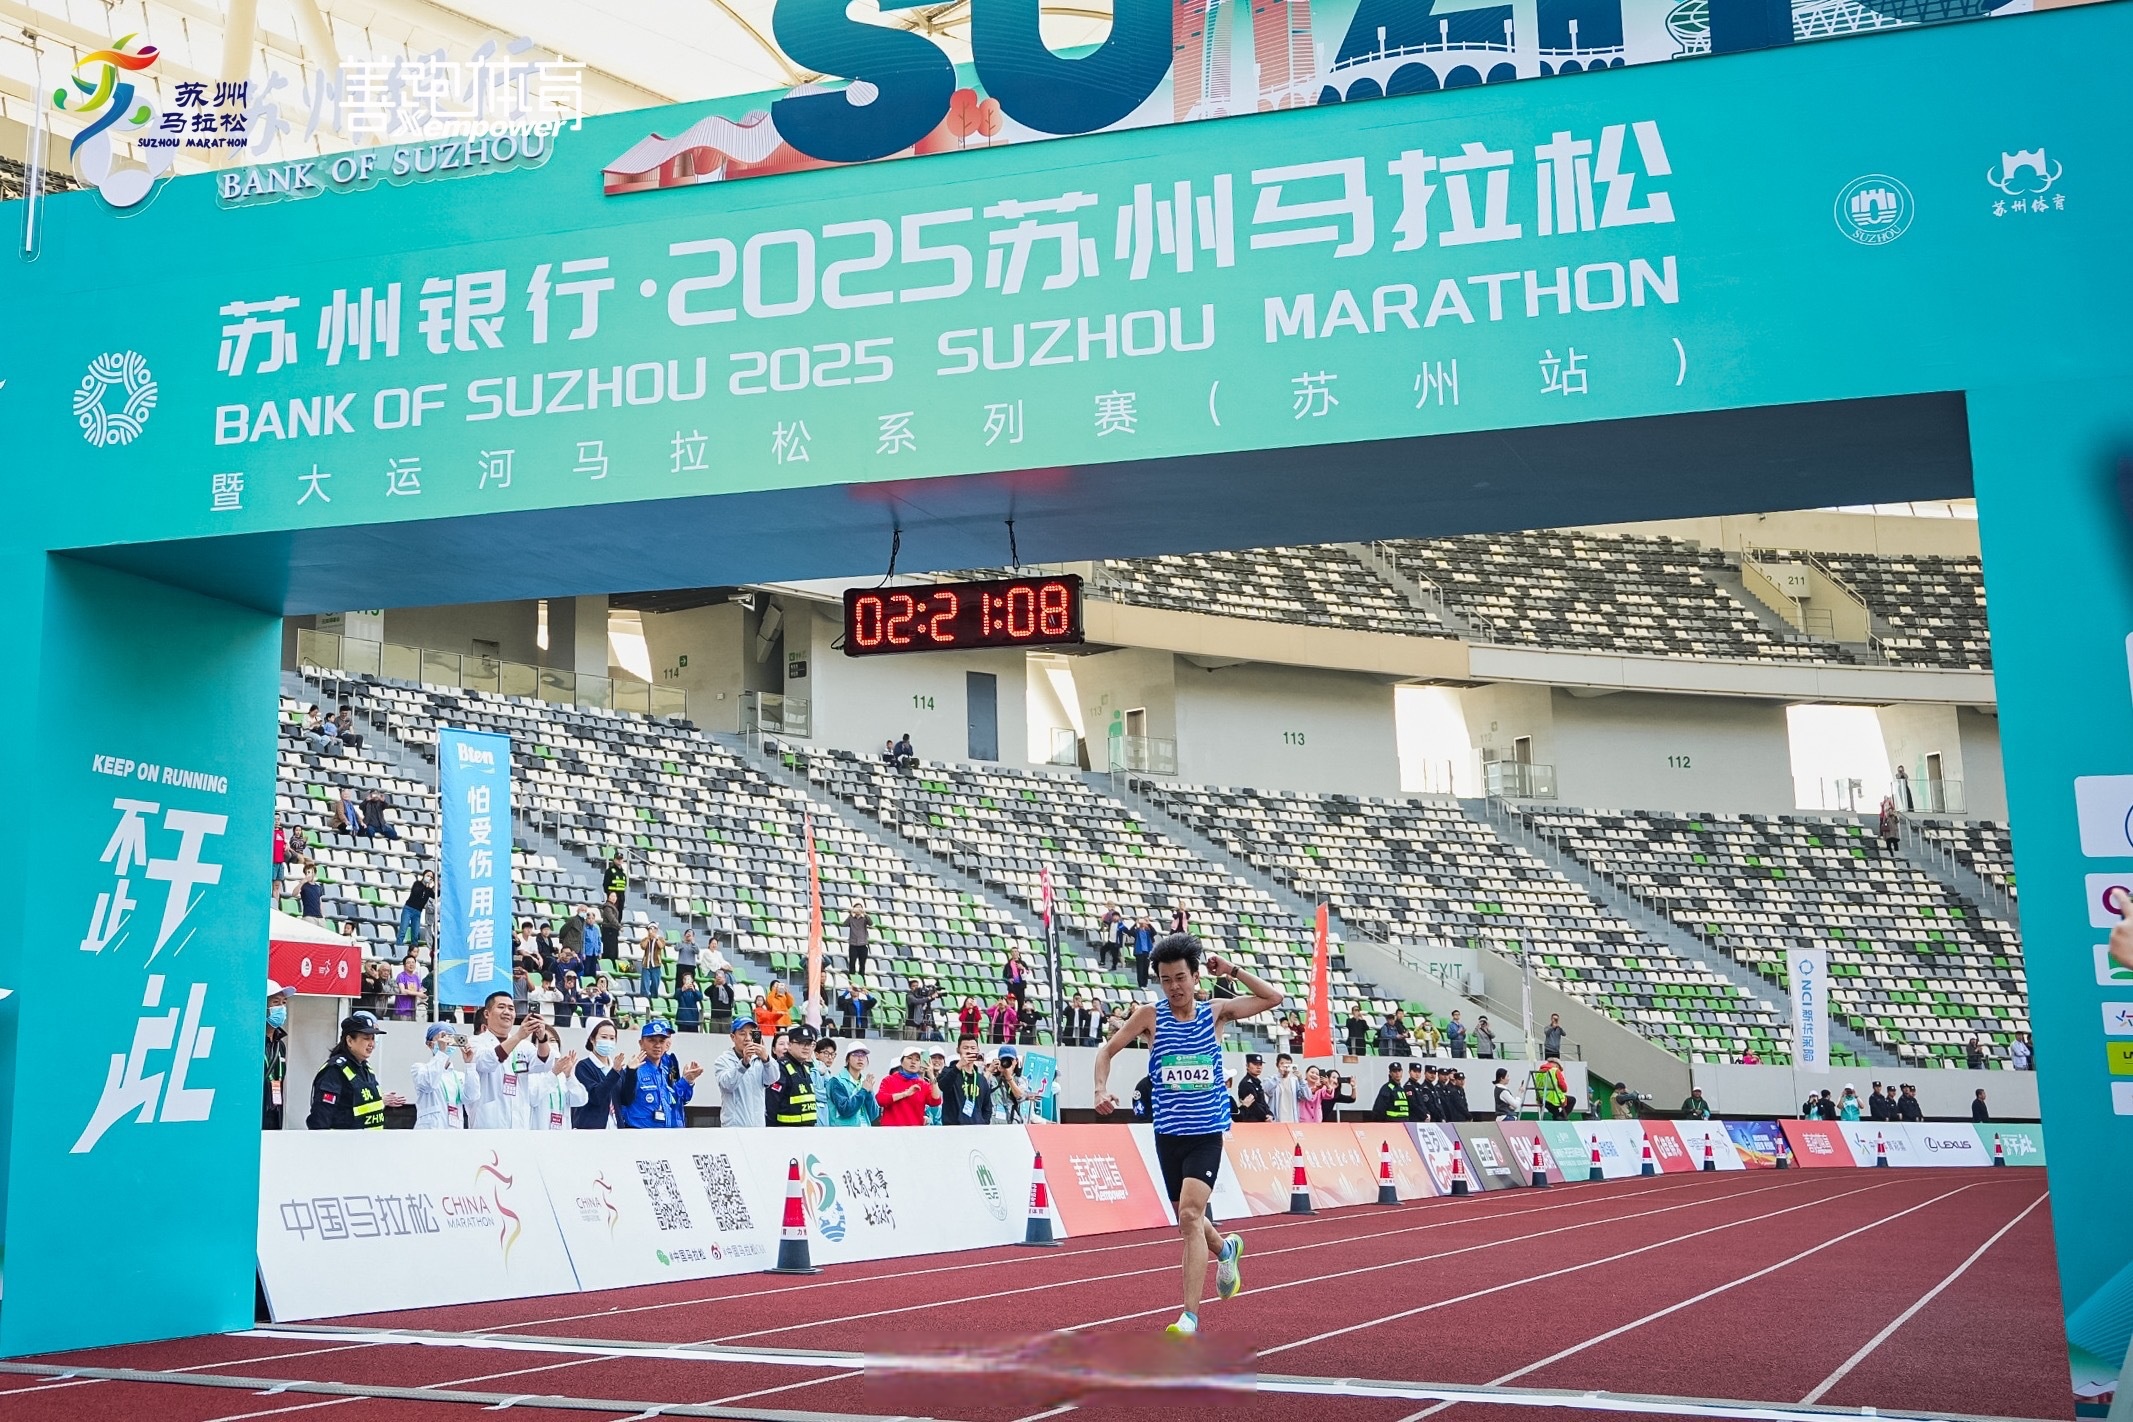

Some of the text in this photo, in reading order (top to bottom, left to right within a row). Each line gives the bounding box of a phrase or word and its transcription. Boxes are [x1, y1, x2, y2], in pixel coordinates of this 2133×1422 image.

[222, 133, 548, 201] BANK OF SUZHOU
[1851, 225, 1903, 244] SUZHOU
[214, 255, 1680, 446] BANK OF SUZHOU 2025 SUZHOU MARATHON
[1788, 576, 1805, 585] 211
[855, 584, 1068, 647] 02:21:08
[663, 668, 680, 679] 114
[912, 694, 935, 711] 114
[1283, 732, 1305, 746] 113
[456, 742, 495, 766] Bten
[1667, 756, 1691, 769] 112
[92, 754, 228, 794] KEEP ON RUNNING
[466, 784, 493, 881] 怕受伤
[1429, 962, 1463, 979] EXIT
[1801, 980, 1814, 1062] NCI 新华保险
[1166, 1069, 1210, 1081] A1042
[1937, 1140, 1972, 1149] LEXUS
[441, 1195, 491, 1217] CHINA
[576, 1197, 602, 1209] CHINA
[280, 1193, 441, 1242] 中国马拉松
[446, 1216, 496, 1229] MARATHON
